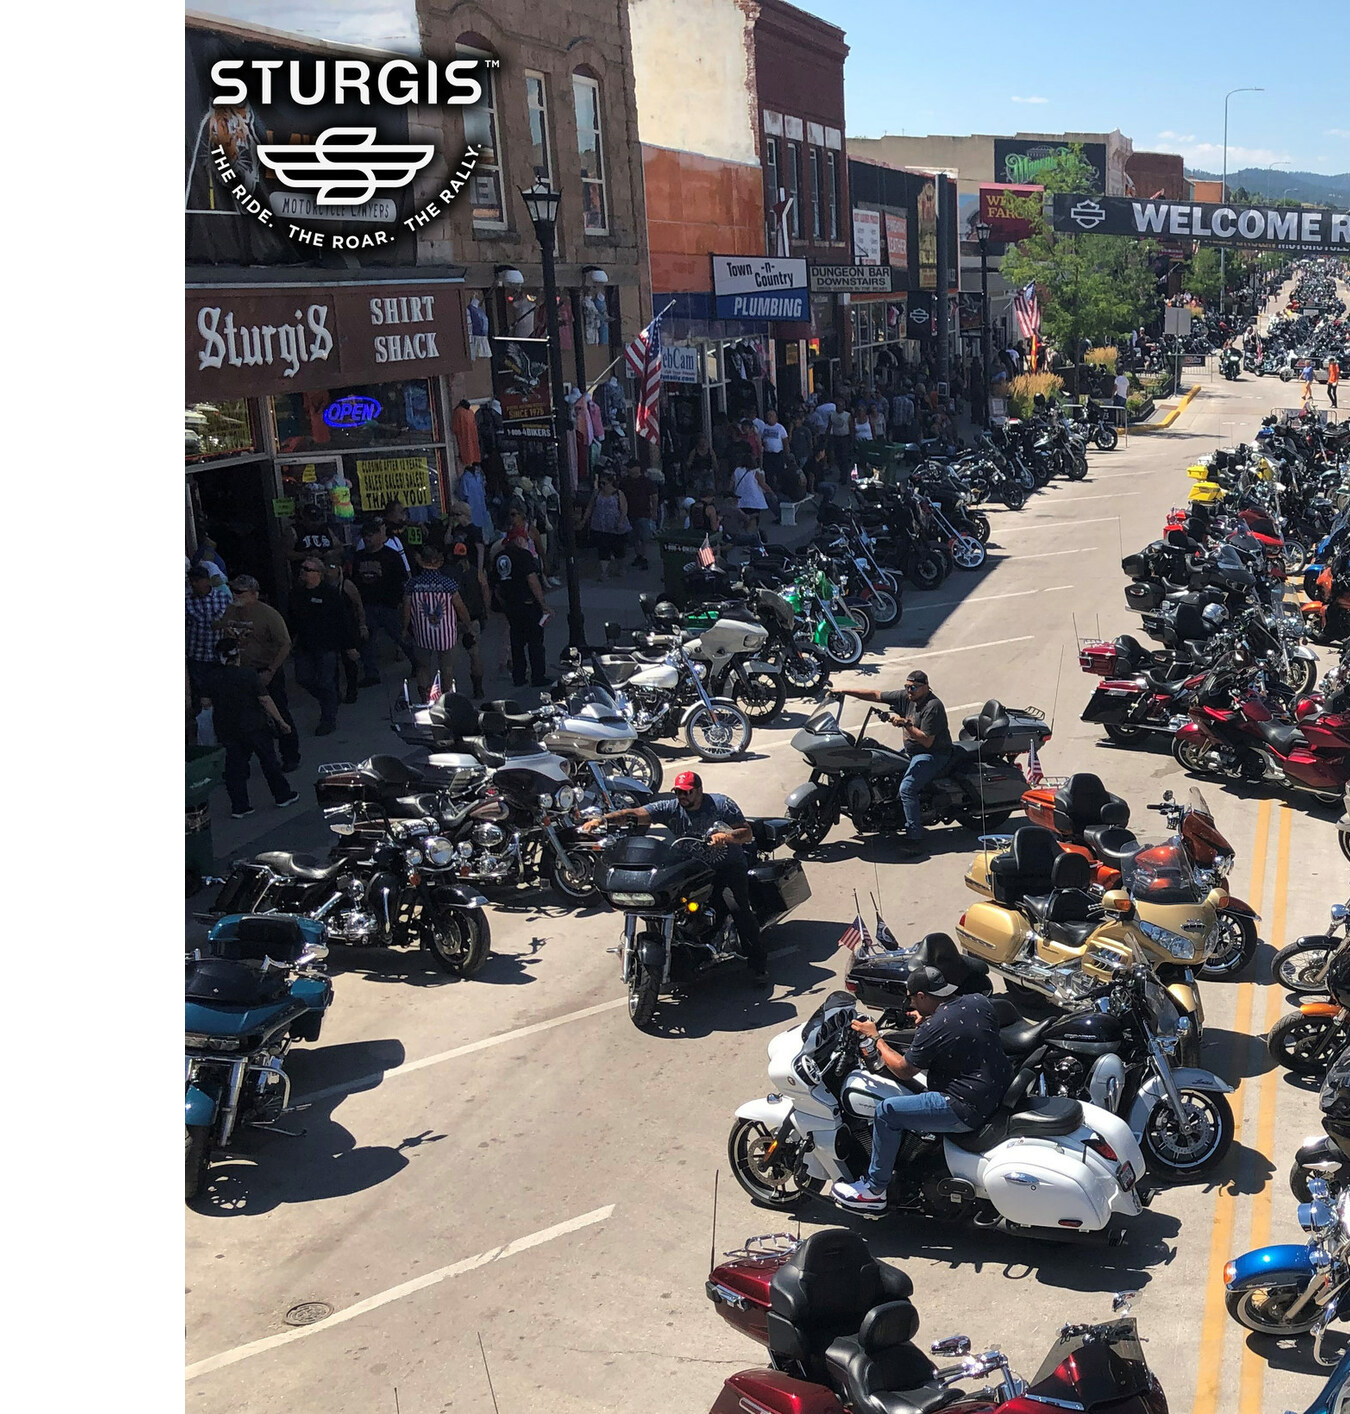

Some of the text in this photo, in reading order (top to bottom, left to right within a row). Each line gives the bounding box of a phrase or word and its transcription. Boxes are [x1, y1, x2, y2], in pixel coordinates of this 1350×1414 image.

[986, 207, 1024, 220] FARG
[1132, 202, 1322, 243] WELCOME
[726, 262, 752, 278] Town
[754, 271, 794, 288] Country
[812, 266, 890, 278] DUNGEON BAR
[816, 278, 886, 286] DOWNSTAIRS
[370, 296, 435, 326] SHIRT
[734, 297, 802, 318] PLUMBING
[374, 332, 440, 364] SHACK
[662, 348, 694, 370] ebCam
[328, 402, 376, 422] OPEN
